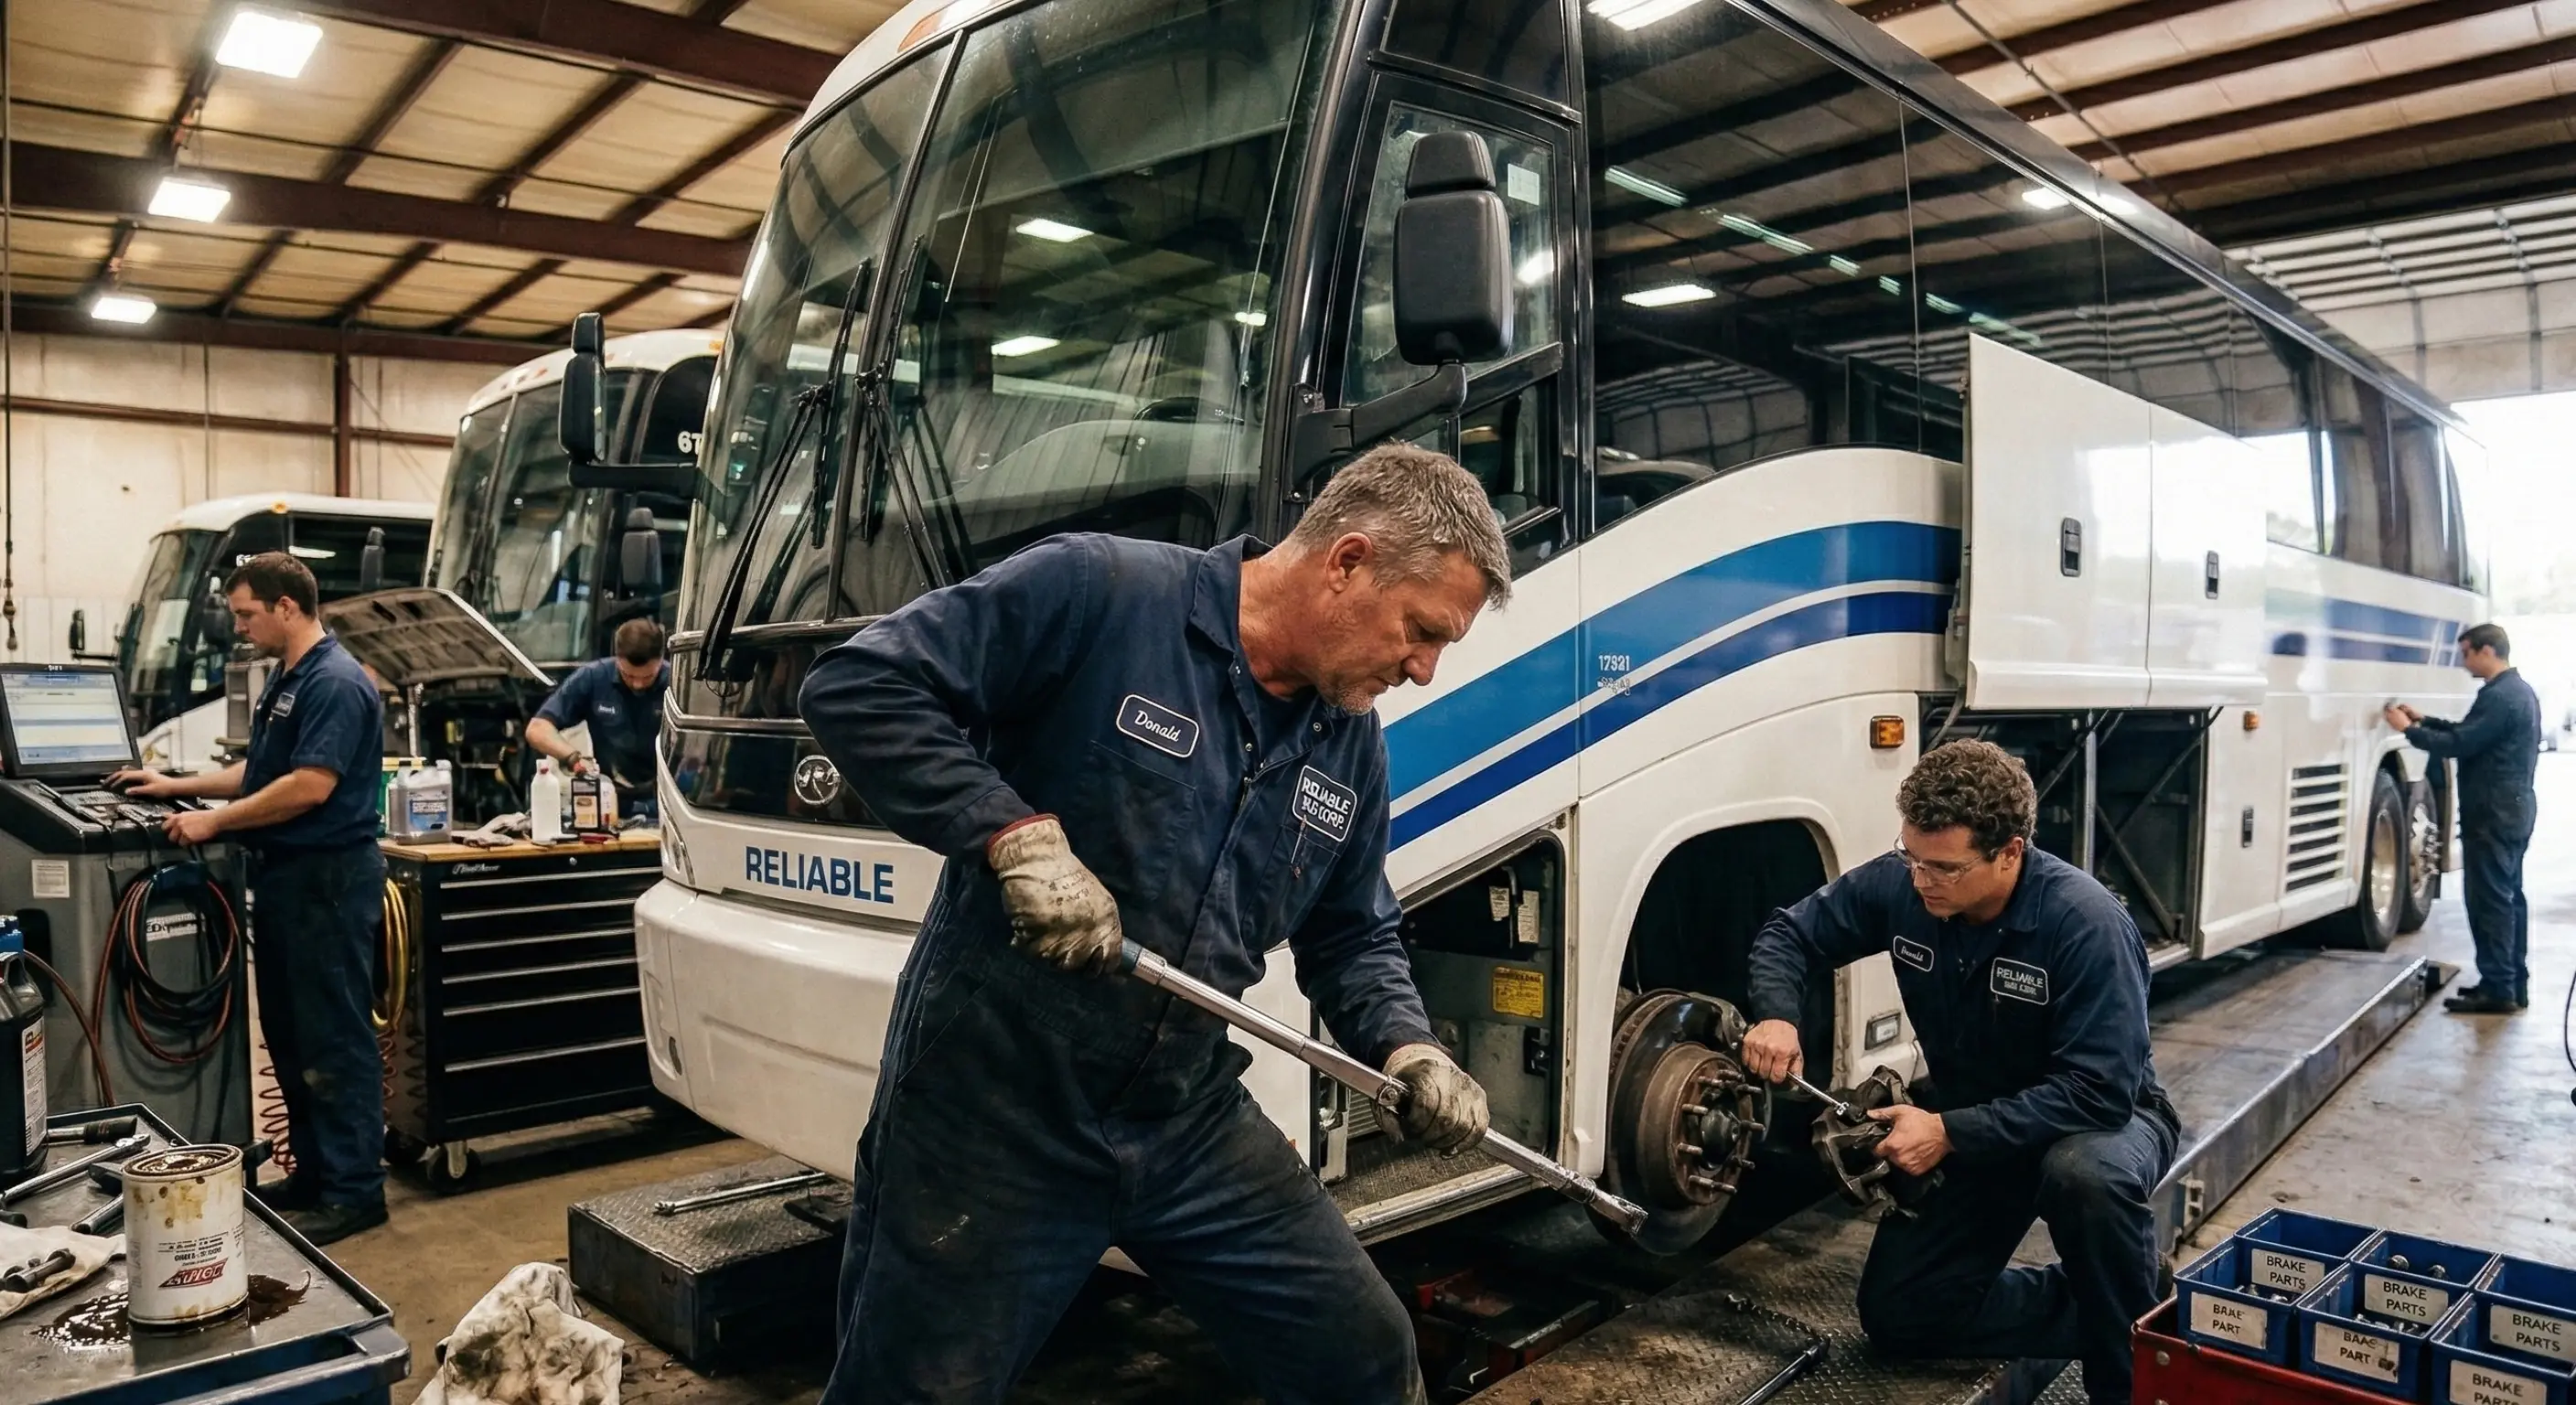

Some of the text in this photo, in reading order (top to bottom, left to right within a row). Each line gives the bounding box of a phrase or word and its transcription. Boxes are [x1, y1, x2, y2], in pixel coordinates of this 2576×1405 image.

[1134, 709, 1182, 742] Donald
[746, 846, 894, 904] RELIABLE
[2267, 1255, 2306, 1273] BRAKE
[2270, 1271, 2306, 1291] PARTS
[2383, 1282, 2427, 1301] BRAKE
[2386, 1299, 2426, 1317] PARTS
[2212, 1319, 2241, 1335] PART
[2512, 1314, 2561, 1335] BRAKE
[2516, 1332, 2560, 1352] PARTS
[2339, 1347, 2371, 1365] PART
[2473, 1373, 2524, 1398] BRAKE
